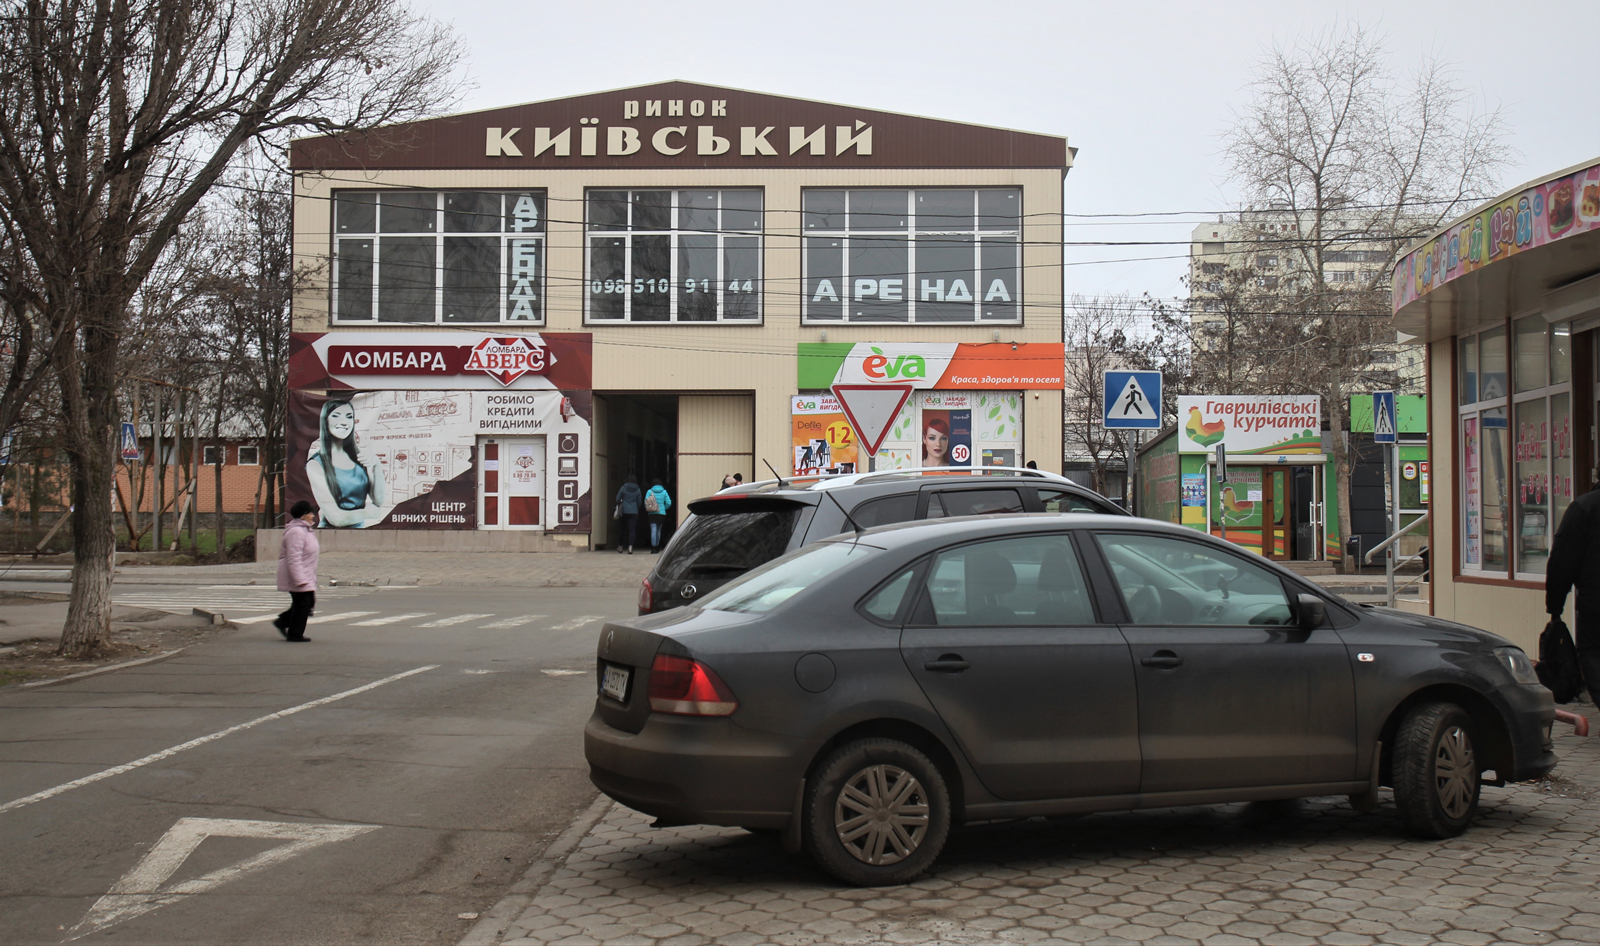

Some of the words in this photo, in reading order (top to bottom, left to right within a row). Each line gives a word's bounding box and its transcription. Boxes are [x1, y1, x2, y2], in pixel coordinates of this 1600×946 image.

[485, 117, 873, 158] КИЇВСЬКИЙ
[1489, 196, 1533, 260] рай
[509, 192, 539, 321] АРЕНДА
[592, 278, 626, 294] 098
[634, 278, 669, 294] 510
[685, 278, 709, 294] 91
[728, 278, 753, 294] 44
[486, 346, 526, 354] ЛОМБАРД
[340, 351, 447, 371] ЛОМБАРД
[466, 351, 543, 369] АВЕРС
[951, 375, 980, 385] Краса,
[981, 375, 1019, 385] здоров'я
[487, 395, 535, 405] РОБИМО
[487, 407, 535, 417] КРЕДИТИ
[1206, 399, 1317, 420] Гаврилівські
[479, 419, 542, 430] ВИГІДНИМИ
[797, 420, 822, 429] Defile
[1233, 412, 1317, 432] курчата
[431, 502, 467, 514] ЦЕНТР
[391, 514, 427, 523] ВІРНИХ
[429, 513, 466, 523] РІШЕНЬ
